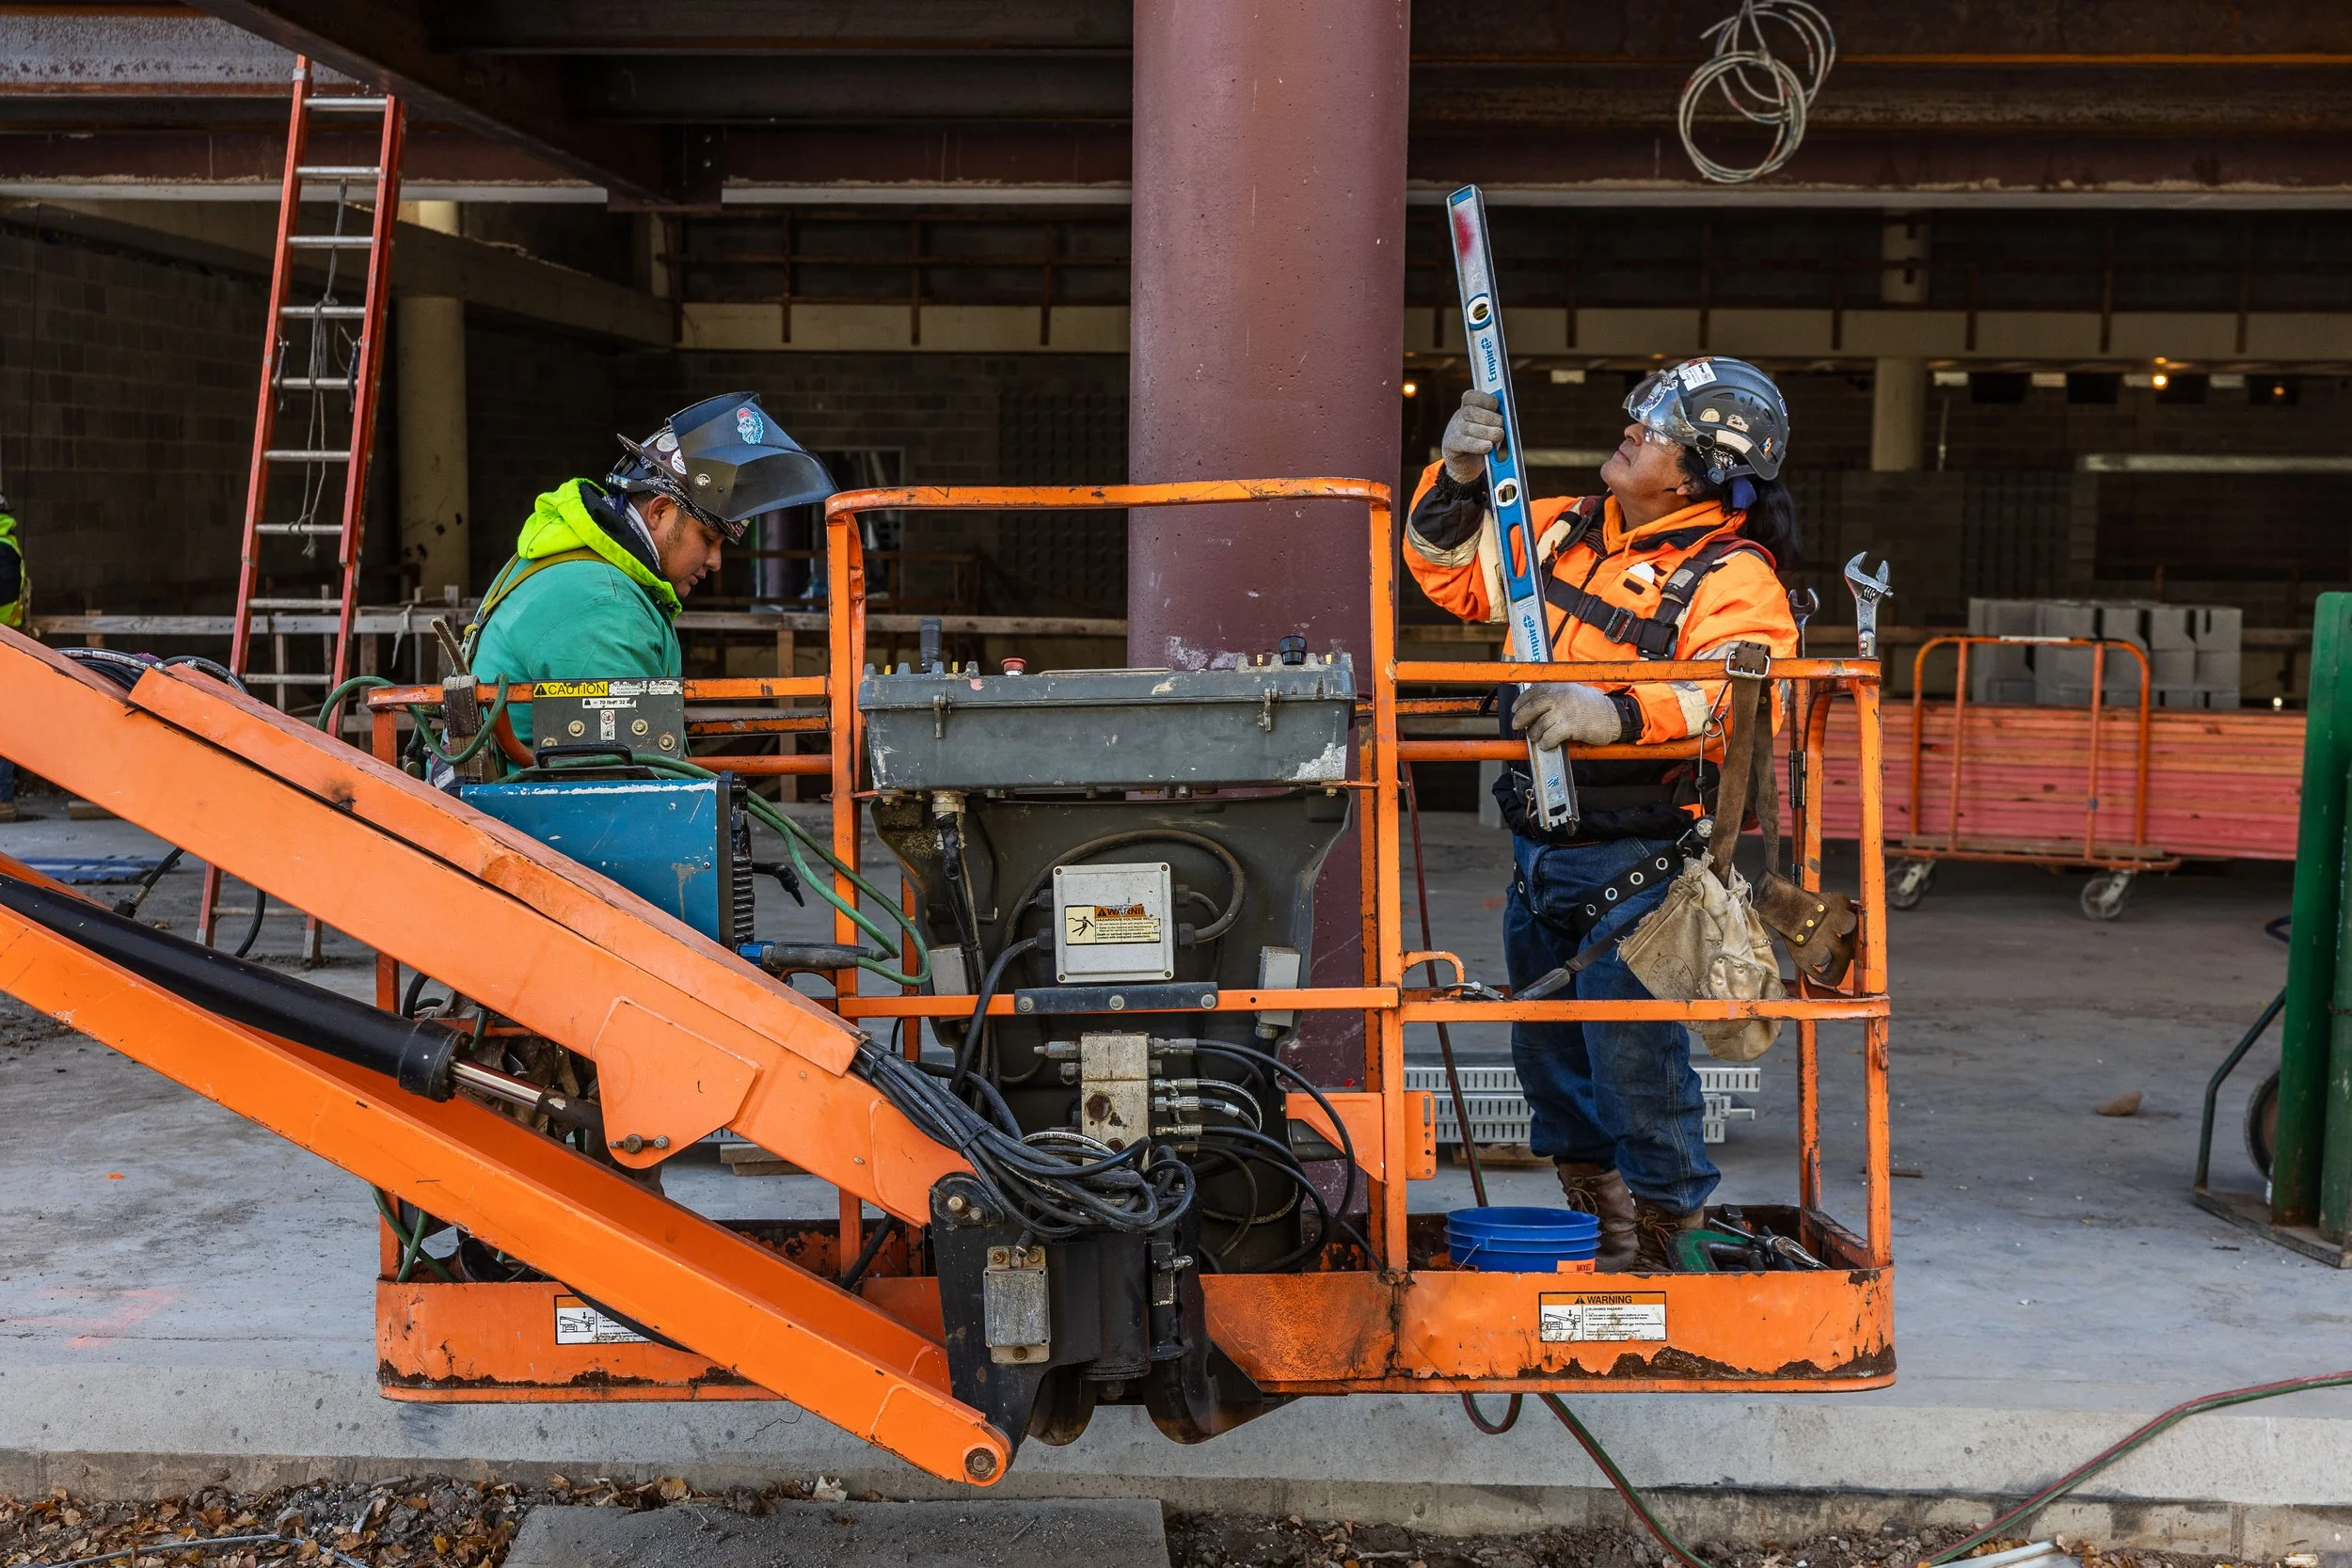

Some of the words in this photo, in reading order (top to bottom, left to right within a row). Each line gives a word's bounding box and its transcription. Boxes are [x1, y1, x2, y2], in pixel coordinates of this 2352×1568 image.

[1483, 339, 1497, 383] Empire
[548, 684, 605, 695] CAUTION
[1587, 1295, 1632, 1305] WARNING
